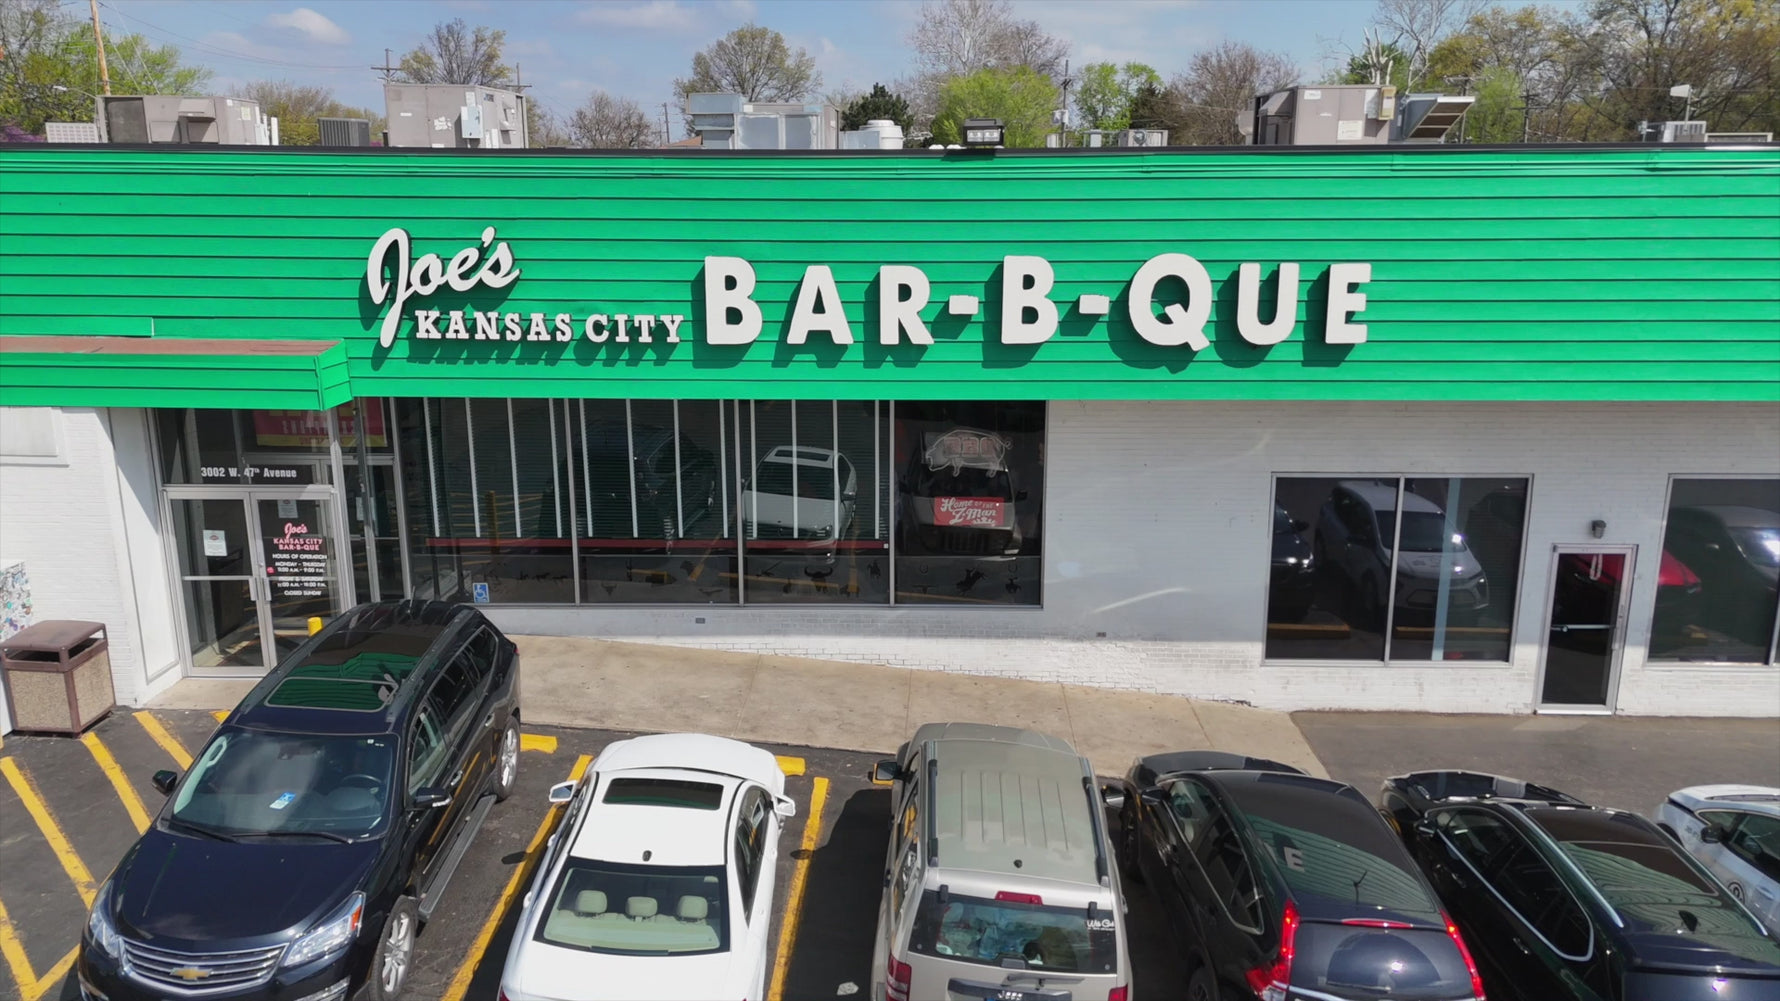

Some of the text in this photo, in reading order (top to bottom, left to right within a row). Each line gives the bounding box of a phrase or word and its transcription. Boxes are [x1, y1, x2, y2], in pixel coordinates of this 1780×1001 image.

[367, 226, 521, 348] Joe's
[704, 252, 1372, 352] BAR-B-QUE
[415, 310, 685, 344] KANSAS CITY
[201, 467, 226, 477] 3002
[229, 467, 240, 477] W.
[263, 468, 297, 478] Avenue
[940, 497, 974, 512] Home
[285, 522, 308, 539] Joe's
